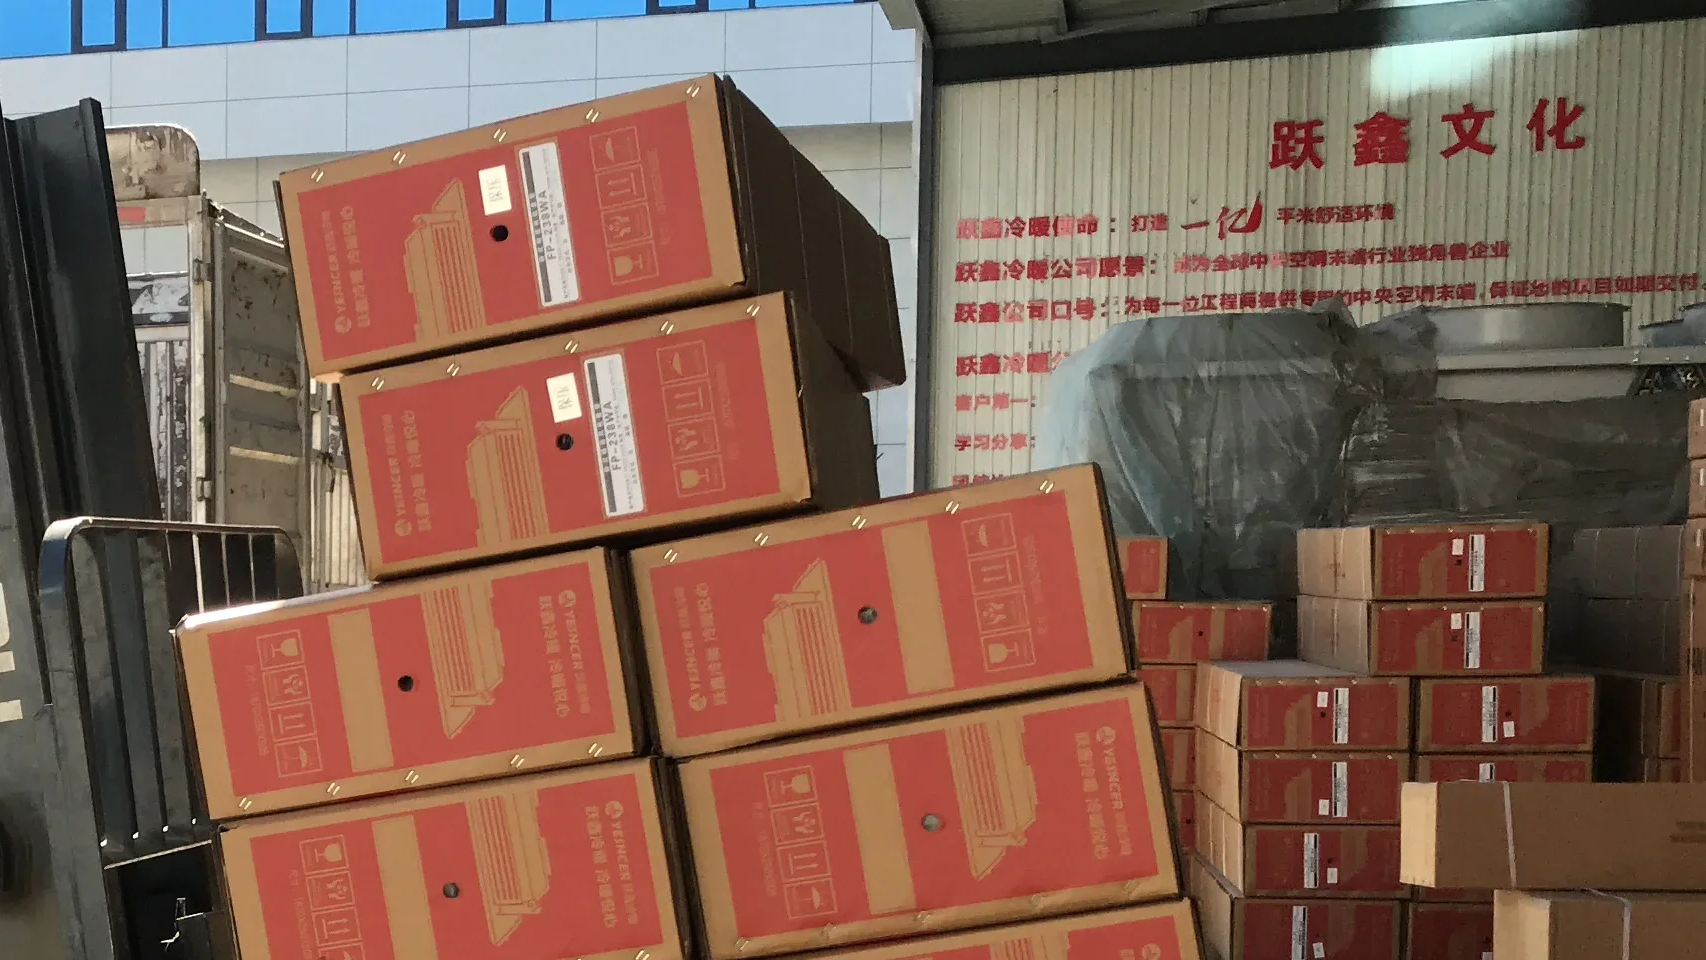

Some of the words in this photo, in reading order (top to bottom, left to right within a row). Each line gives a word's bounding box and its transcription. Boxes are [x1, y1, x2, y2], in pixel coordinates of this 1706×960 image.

[1269, 97, 1586, 170] 跃鑫文化
[1131, 212, 1169, 233] 打造
[1181, 190, 1263, 240] 一亿
